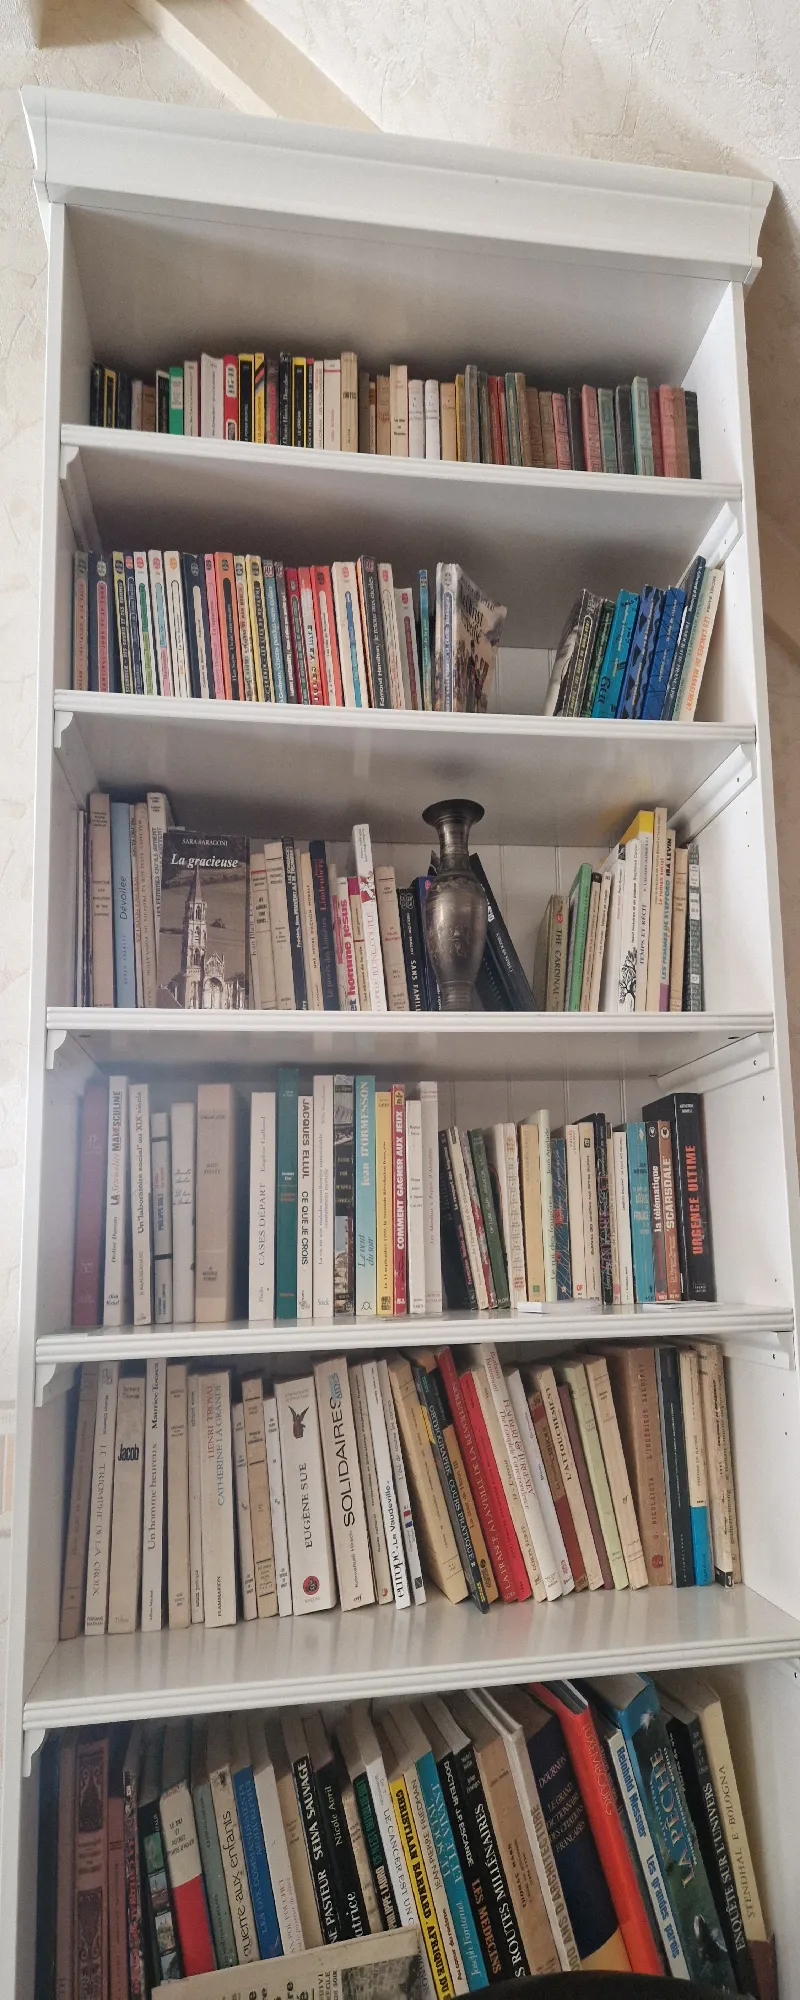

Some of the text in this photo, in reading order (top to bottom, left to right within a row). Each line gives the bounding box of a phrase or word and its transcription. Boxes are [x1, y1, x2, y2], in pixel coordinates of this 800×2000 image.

[374, 645, 382, 676] Hamilton
[695, 657, 702, 666] DU
[696, 629, 707, 657] CANCRES
[377, 678, 385, 706] Edmond
[686, 668, 700, 712] MANAGEMENT
[171, 854, 238, 868] La gracieuse
[119, 875, 128, 920] Dévoilée
[341, 899, 352, 938] jesus
[659, 897, 663, 905] Le
[344, 942, 356, 996] homme
[410, 960, 422, 1011] SANS FAMILL
[554, 951, 563, 995] CARDINAL
[302, 1098, 310, 1146] JACQUES
[359, 1081, 370, 1186] Jean D'ORMESSON
[302, 1149, 310, 1180] ELLUL
[395, 1111, 405, 1250] COMMENT GAGNER AUX JEUX
[256, 1182, 266, 1227] DÉPART
[302, 1191, 309, 1203] CE
[651, 1165, 662, 1232] la télématique
[685, 1145, 704, 1255] URGENCE ULTIME
[258, 1230, 266, 1266] CASES
[301, 1238, 309, 1265] CROIS
[302, 1224, 309, 1236] JE
[358, 1234, 367, 1267] Le vent
[367, 1237, 375, 1266] du soir
[151, 1392, 159, 1429] Maurice
[117, 1443, 139, 1461] Jacob
[206, 1424, 215, 1459] HENRI
[329, 1396, 356, 1528] SOLIDAIRES
[95, 1463, 105, 1521] TRIOMPHE
[216, 1444, 225, 1506] CATHERINE
[428, 1405, 452, 1476] ORTHOGRAPHE
[448, 1479, 458, 1512] COURS
[456, 1513, 475, 1560] PRATIQUE
[148, 1489, 157, 1530] homme
[298, 1462, 314, 1549] EUGÈNE SUE
[147, 1531, 156, 1550] Un
[491, 1535, 509, 1573] FRANCE
[92, 1561, 101, 1596] CROIX
[503, 1573, 512, 1590] LA
[583, 1723, 614, 1816] LUXEMBOURG
[325, 1785, 343, 1847] Nicole Avril
[443, 1760, 459, 1806] DOCTEUR
[457, 1822, 475, 1867] ESCANDE
[616, 1747, 635, 1793] Reinhold
[629, 1795, 647, 1838] Messner
[645, 1855, 657, 1876] Les
[651, 1877, 670, 1921] grandes
[649, 1747, 695, 1887] LA PÊCHE
[220, 1810, 239, 1869] enfants
[296, 1759, 335, 1925] PASTEUR SELVA SAUVAGE
[383, 1808, 413, 1915] LE CANCER EST UN
[718, 1765, 755, 1918] STENDHAL E BOLOGNA
[231, 1873, 244, 1902] aux
[375, 1866, 391, 1893] LABRO
[474, 1803, 523, 1969] ROUTES MILLÉNAIRES
[530, 1805, 575, 1944] ANS D'ARCHITECTURE
[702, 1782, 747, 1952] ENQUÊTE SUR L'UNIVERS
[397, 1789, 419, 1860] CHRISTIAAN
[425, 1925, 443, 1976] AFRIQUE
[438, 1978, 448, 1992] DU
[471, 1879, 485, 1902] LES
[464, 1946, 481, 1976] Joseph
